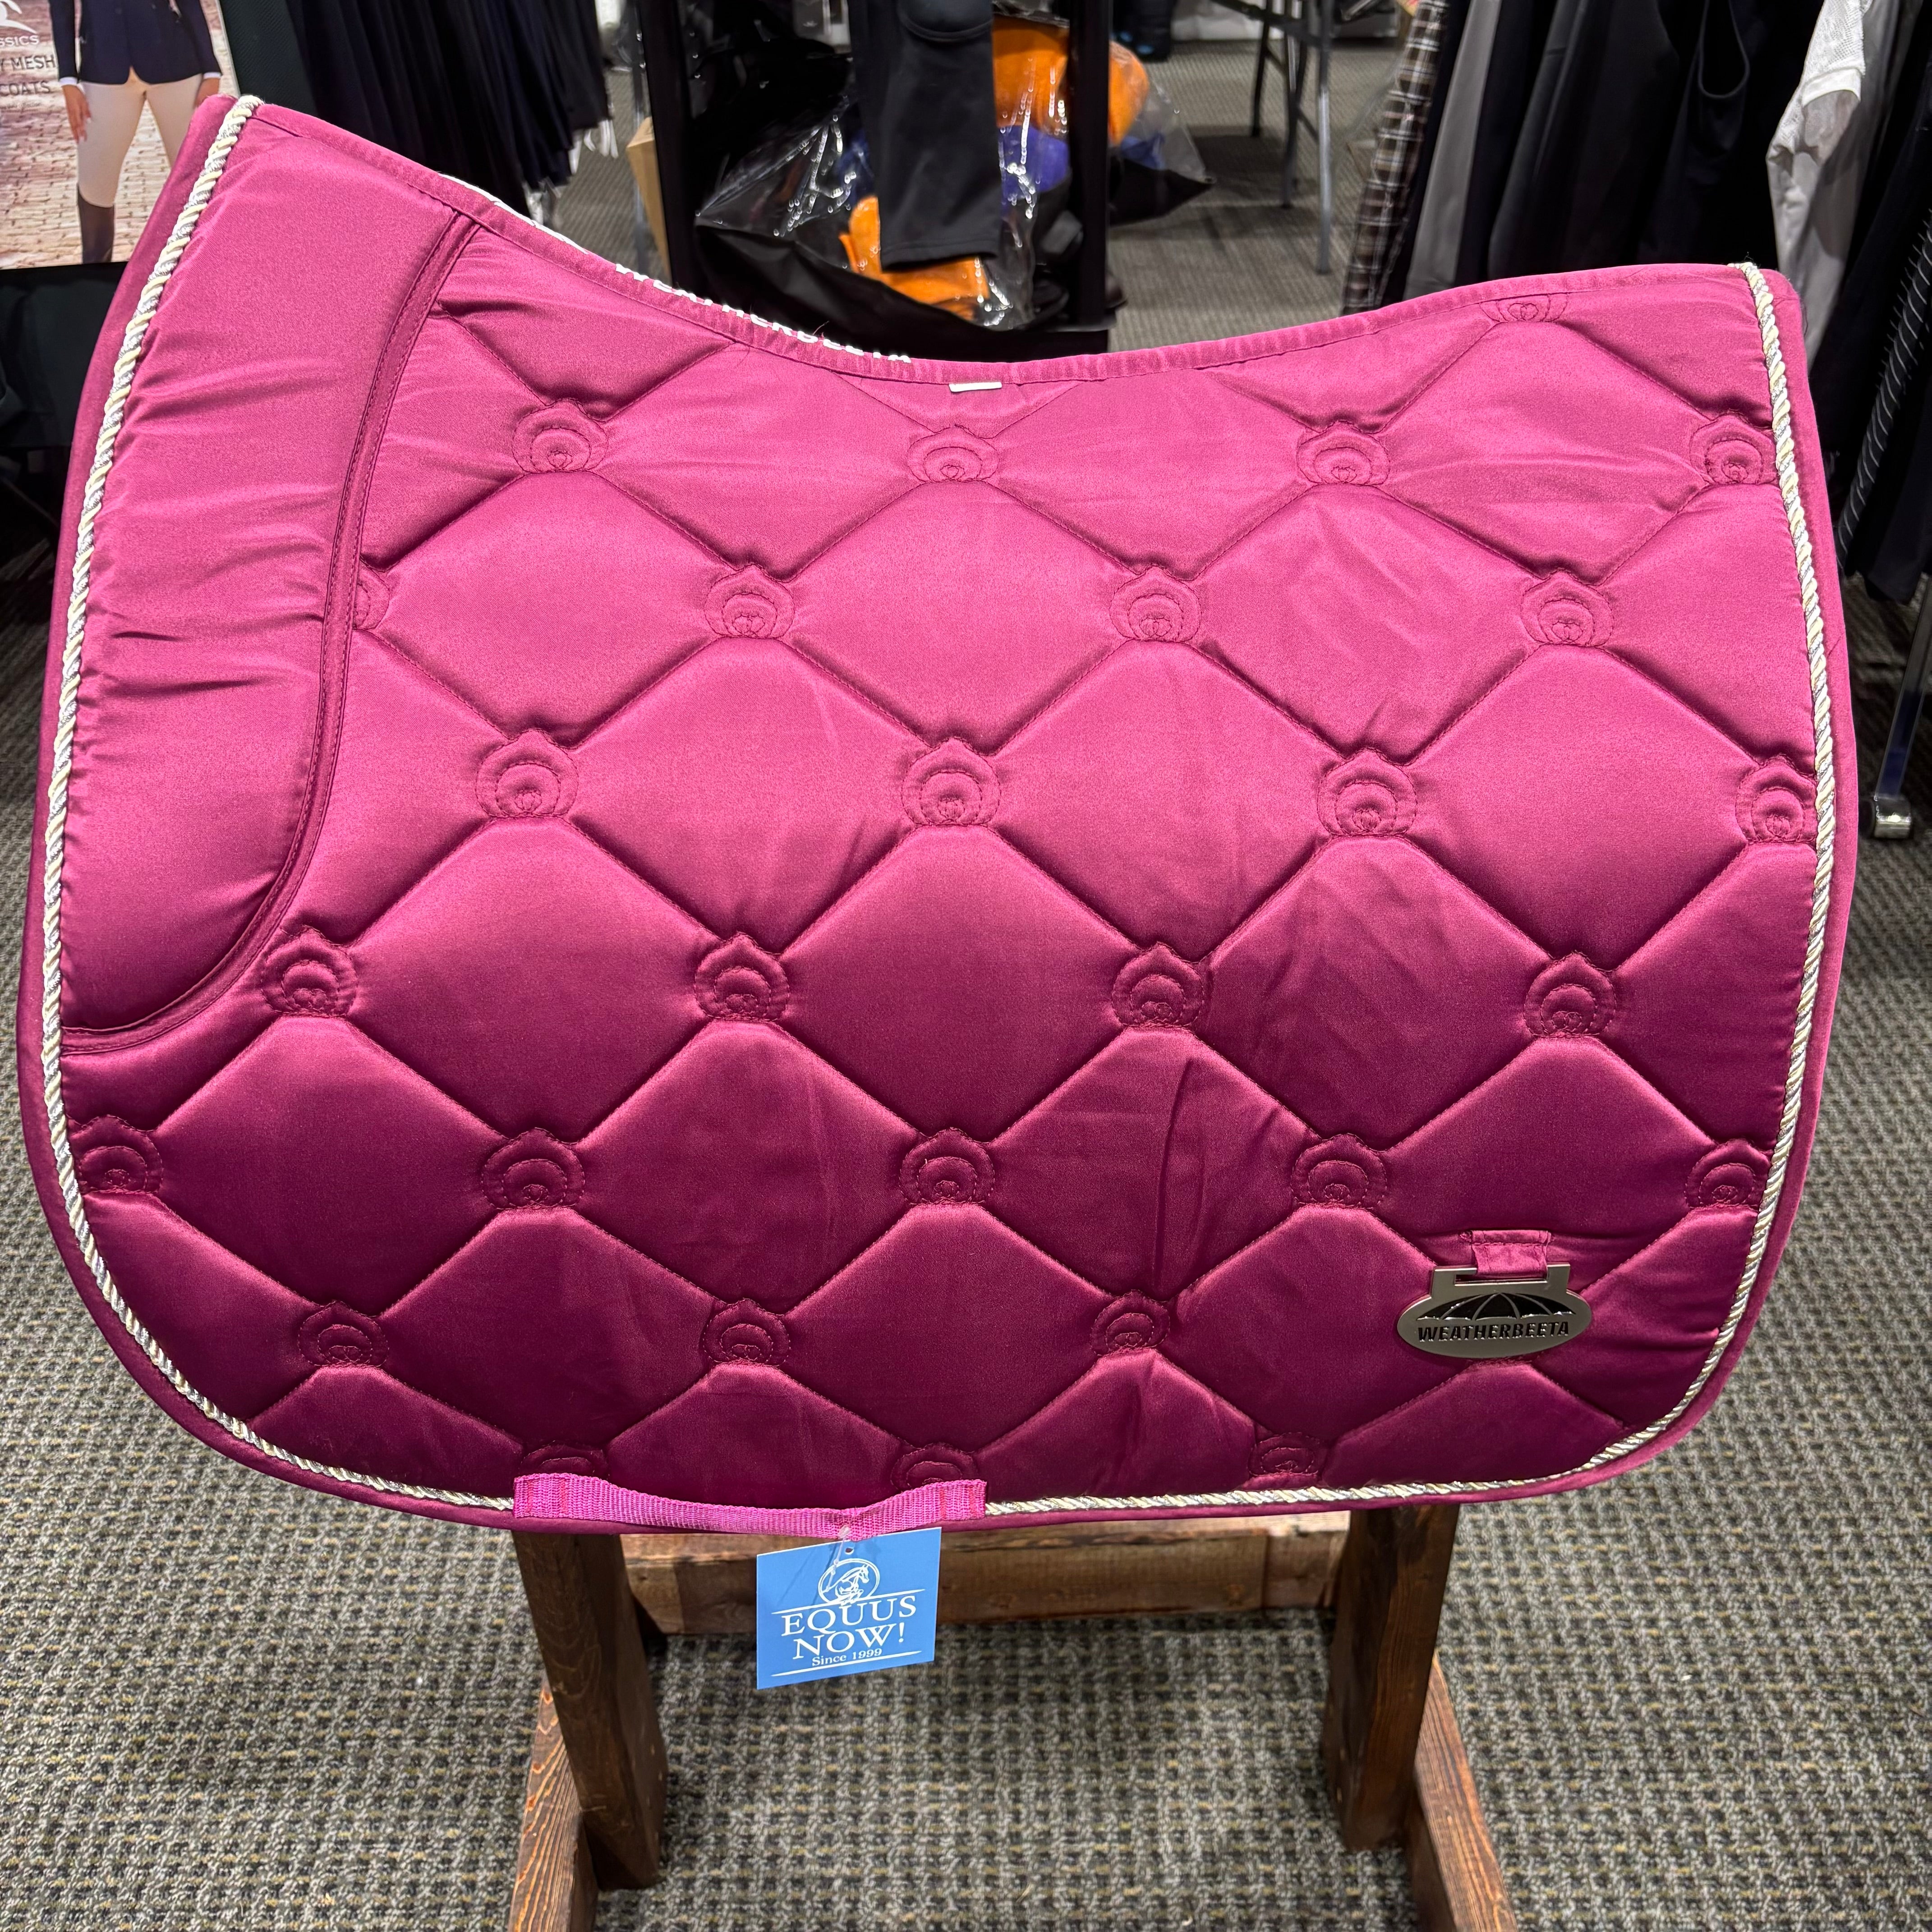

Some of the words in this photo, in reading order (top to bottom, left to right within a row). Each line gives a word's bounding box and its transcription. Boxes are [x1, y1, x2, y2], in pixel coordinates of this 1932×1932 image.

[11, 54, 56, 71] MESH
[1417, 1321, 1569, 1343] WEATHERBEETA
[781, 1595, 917, 1637] EQUUS
[792, 1622, 905, 1660] NOW!
[811, 1654, 847, 1666] Since
[852, 1647, 883, 1660] 1999
